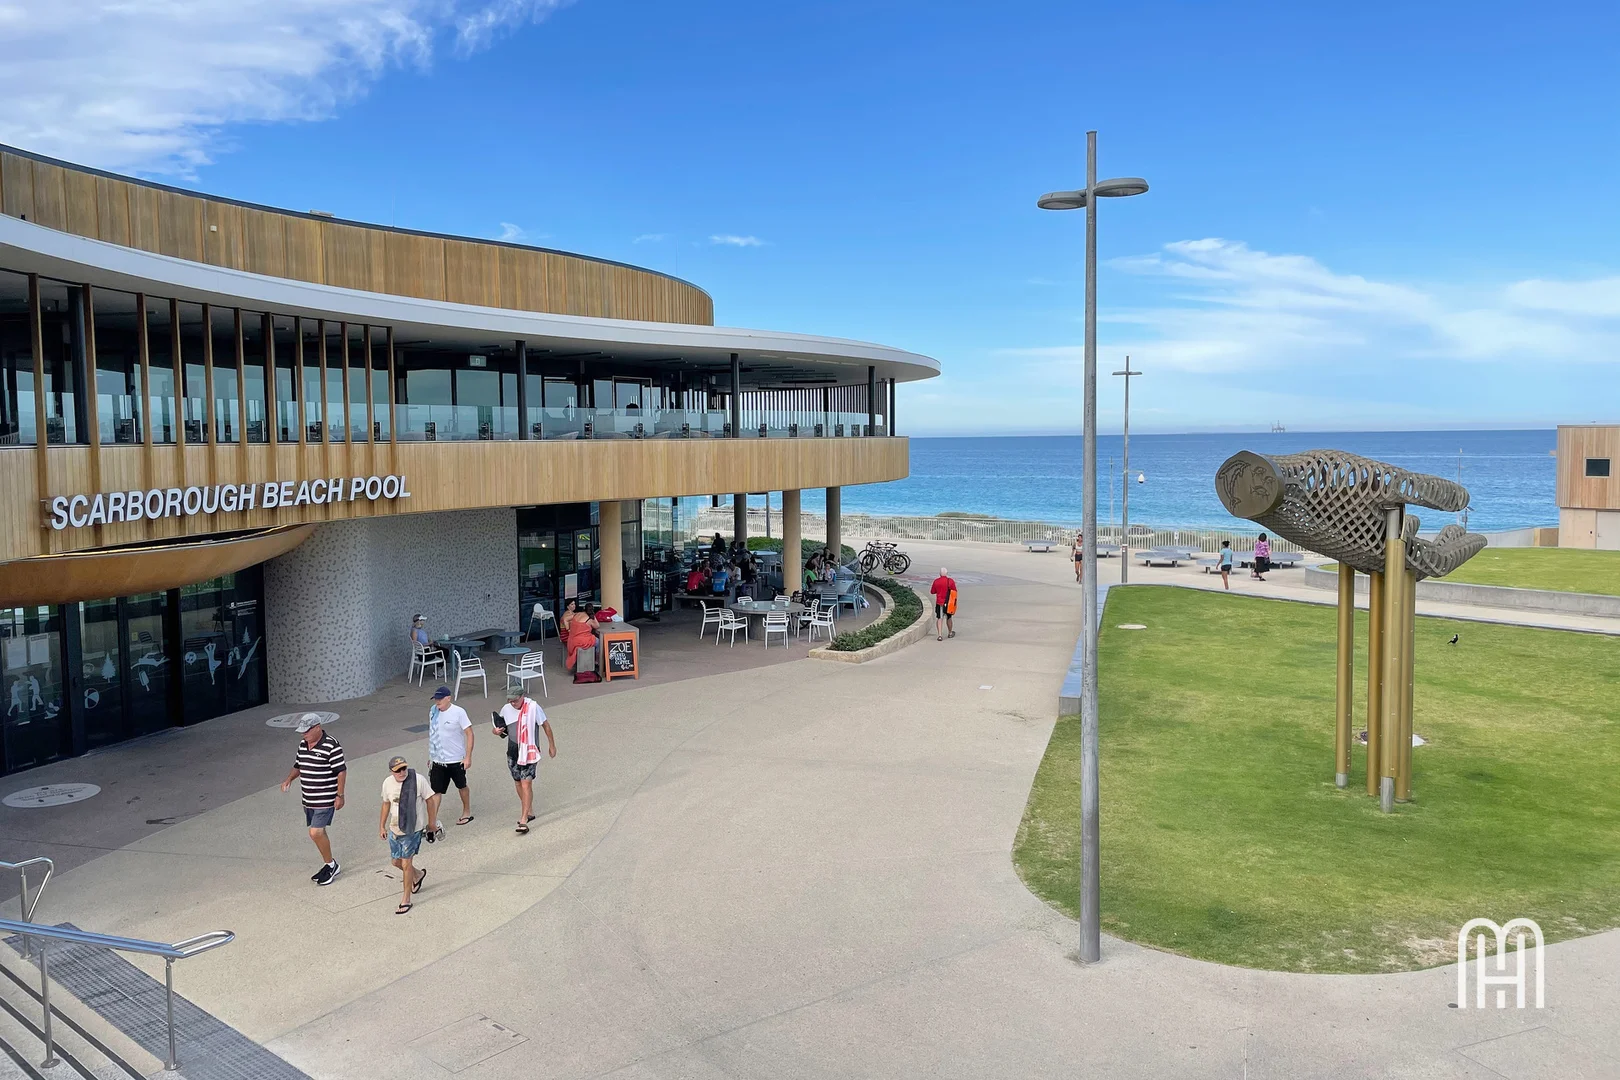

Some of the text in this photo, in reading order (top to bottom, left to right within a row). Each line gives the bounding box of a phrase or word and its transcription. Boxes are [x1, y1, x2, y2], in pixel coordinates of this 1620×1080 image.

[51, 475, 411, 530] SCARBOROUGH BEACH POOL
